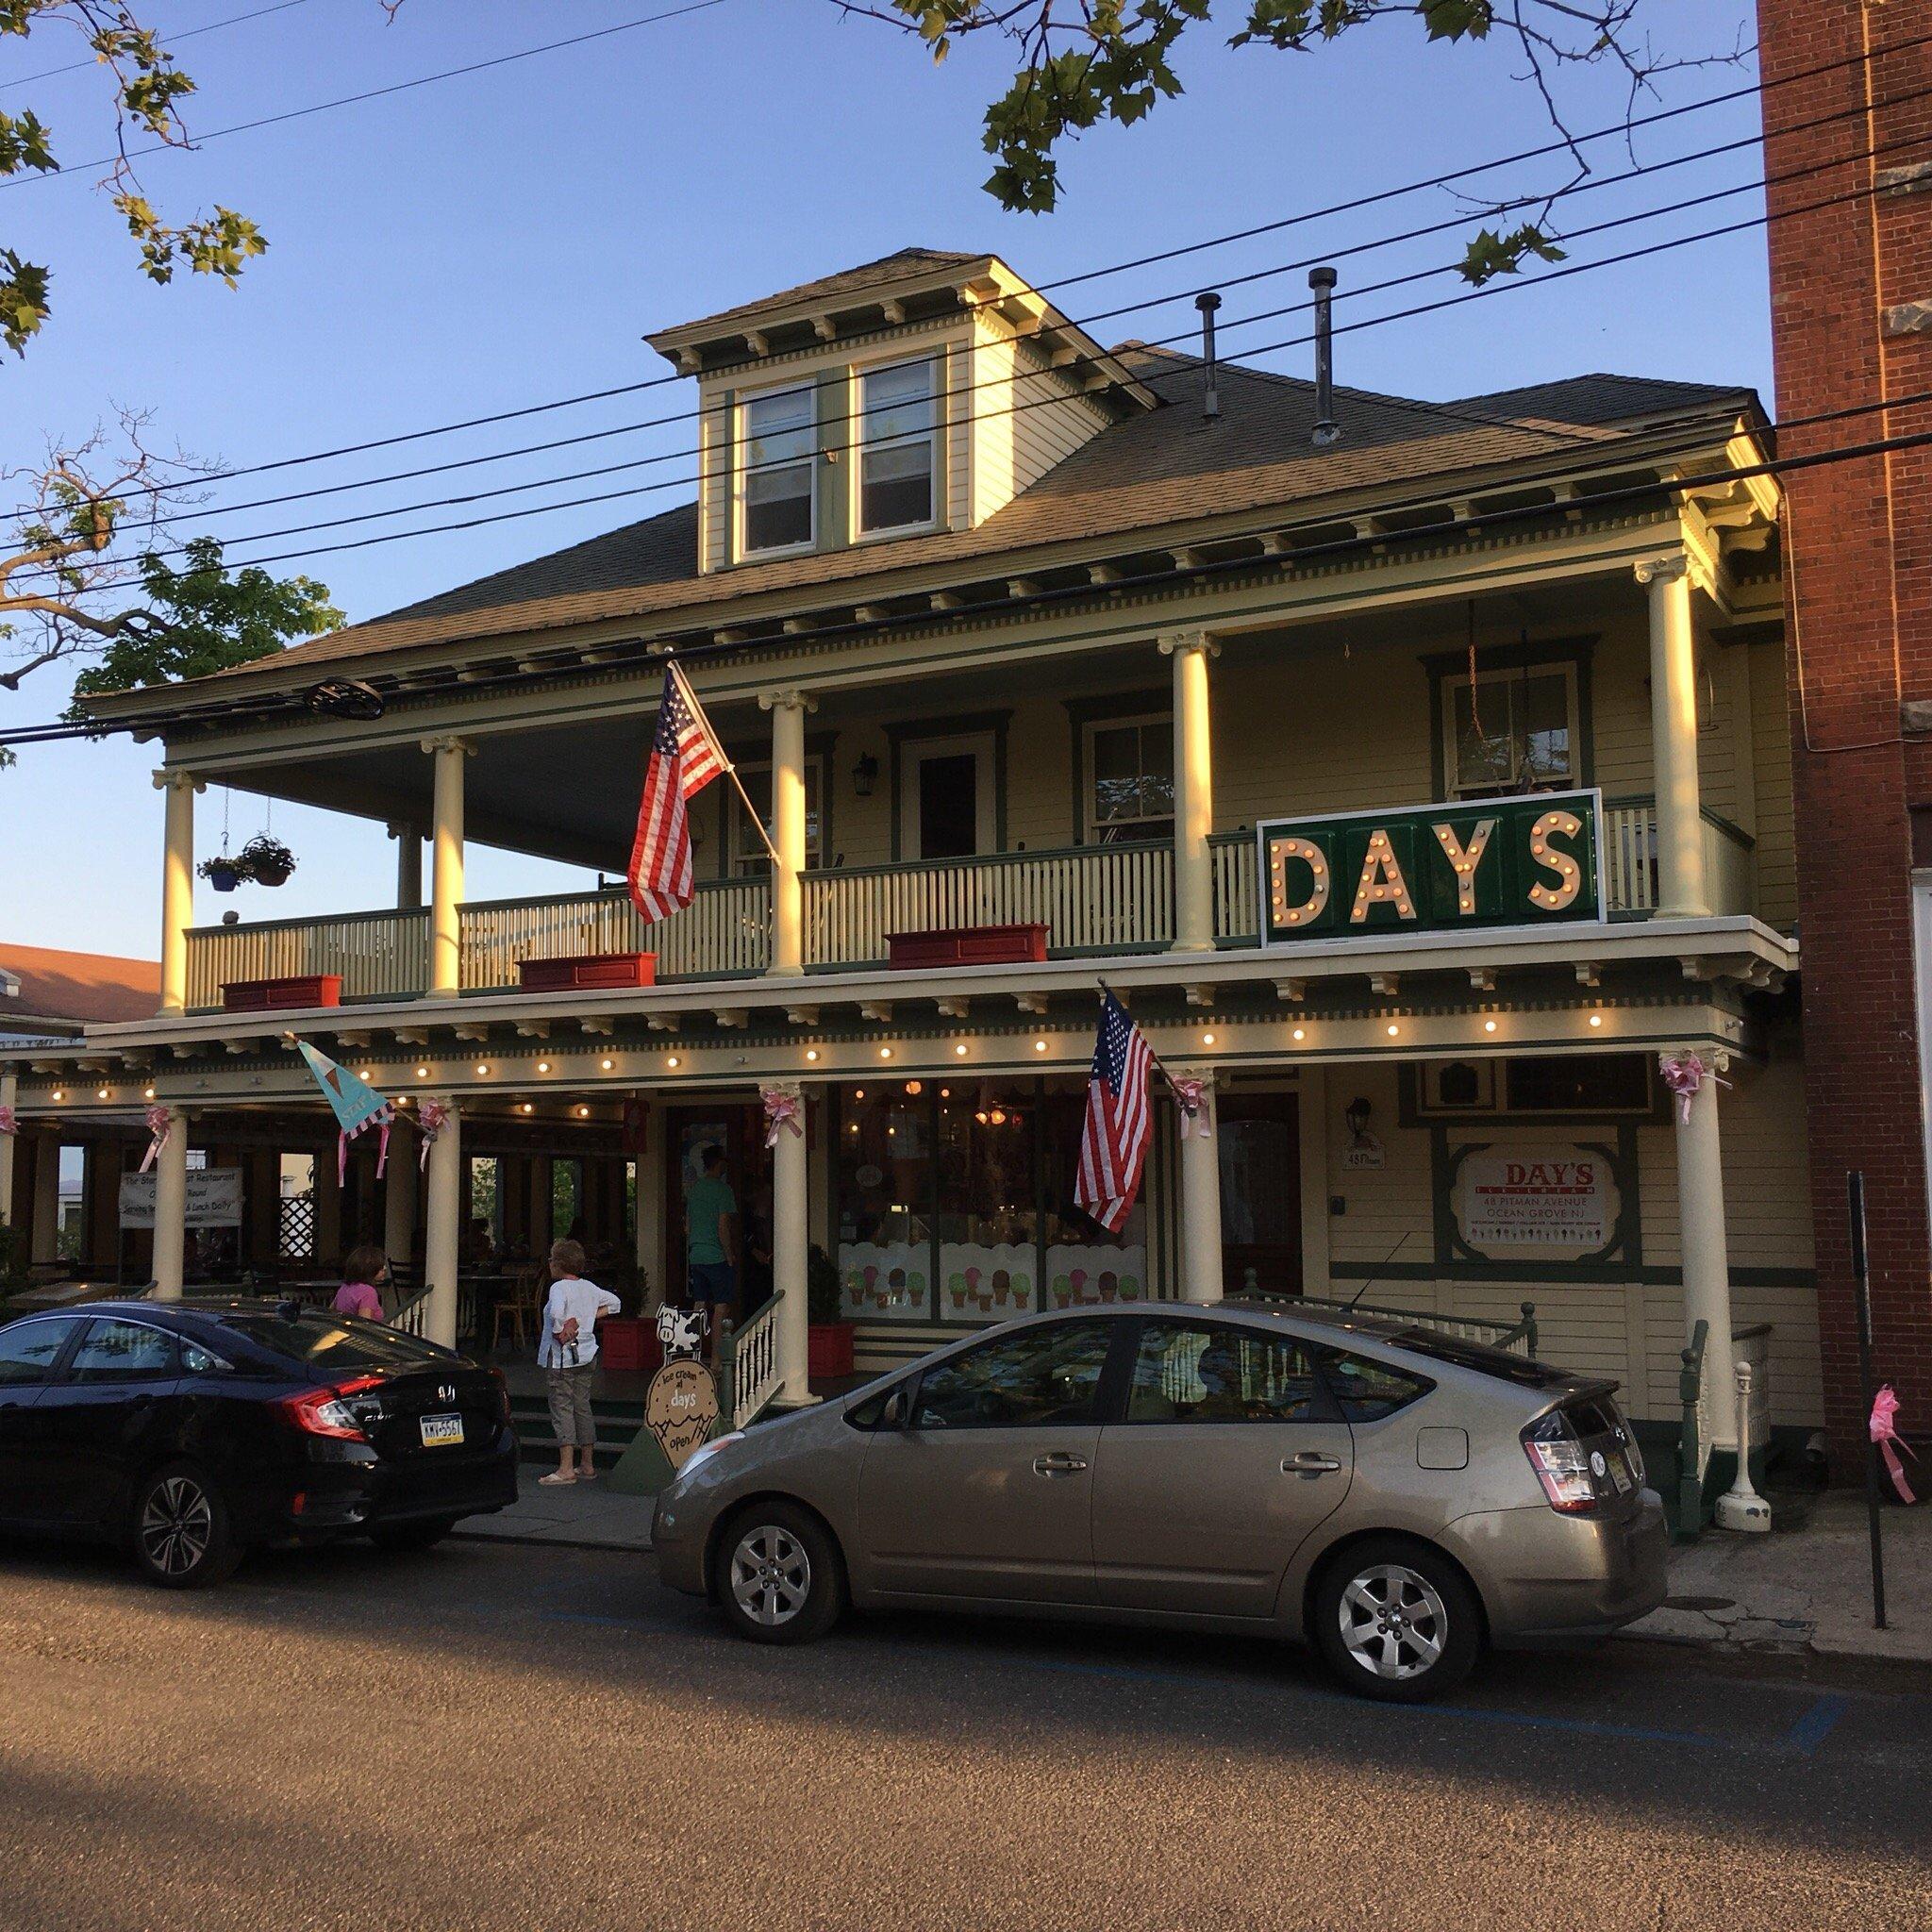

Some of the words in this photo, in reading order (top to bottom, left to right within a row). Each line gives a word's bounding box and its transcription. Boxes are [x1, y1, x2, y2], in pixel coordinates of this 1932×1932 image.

[1270, 811, 1583, 928] DAYS
[1506, 1163, 1593, 1186] DAY'S
[1484, 1197, 1496, 1206] 48
[1500, 1197, 1541, 1207] PITMAN
[1543, 1197, 1588, 1207] AVENUE
[1487, 1208, 1525, 1218] OCEAN
[1529, 1208, 1567, 1218] GROVE
[1571, 1208, 1586, 1218] NJ
[675, 1370, 697, 1381] cream
[671, 1389, 696, 1409] days
[669, 1436, 691, 1452] open
